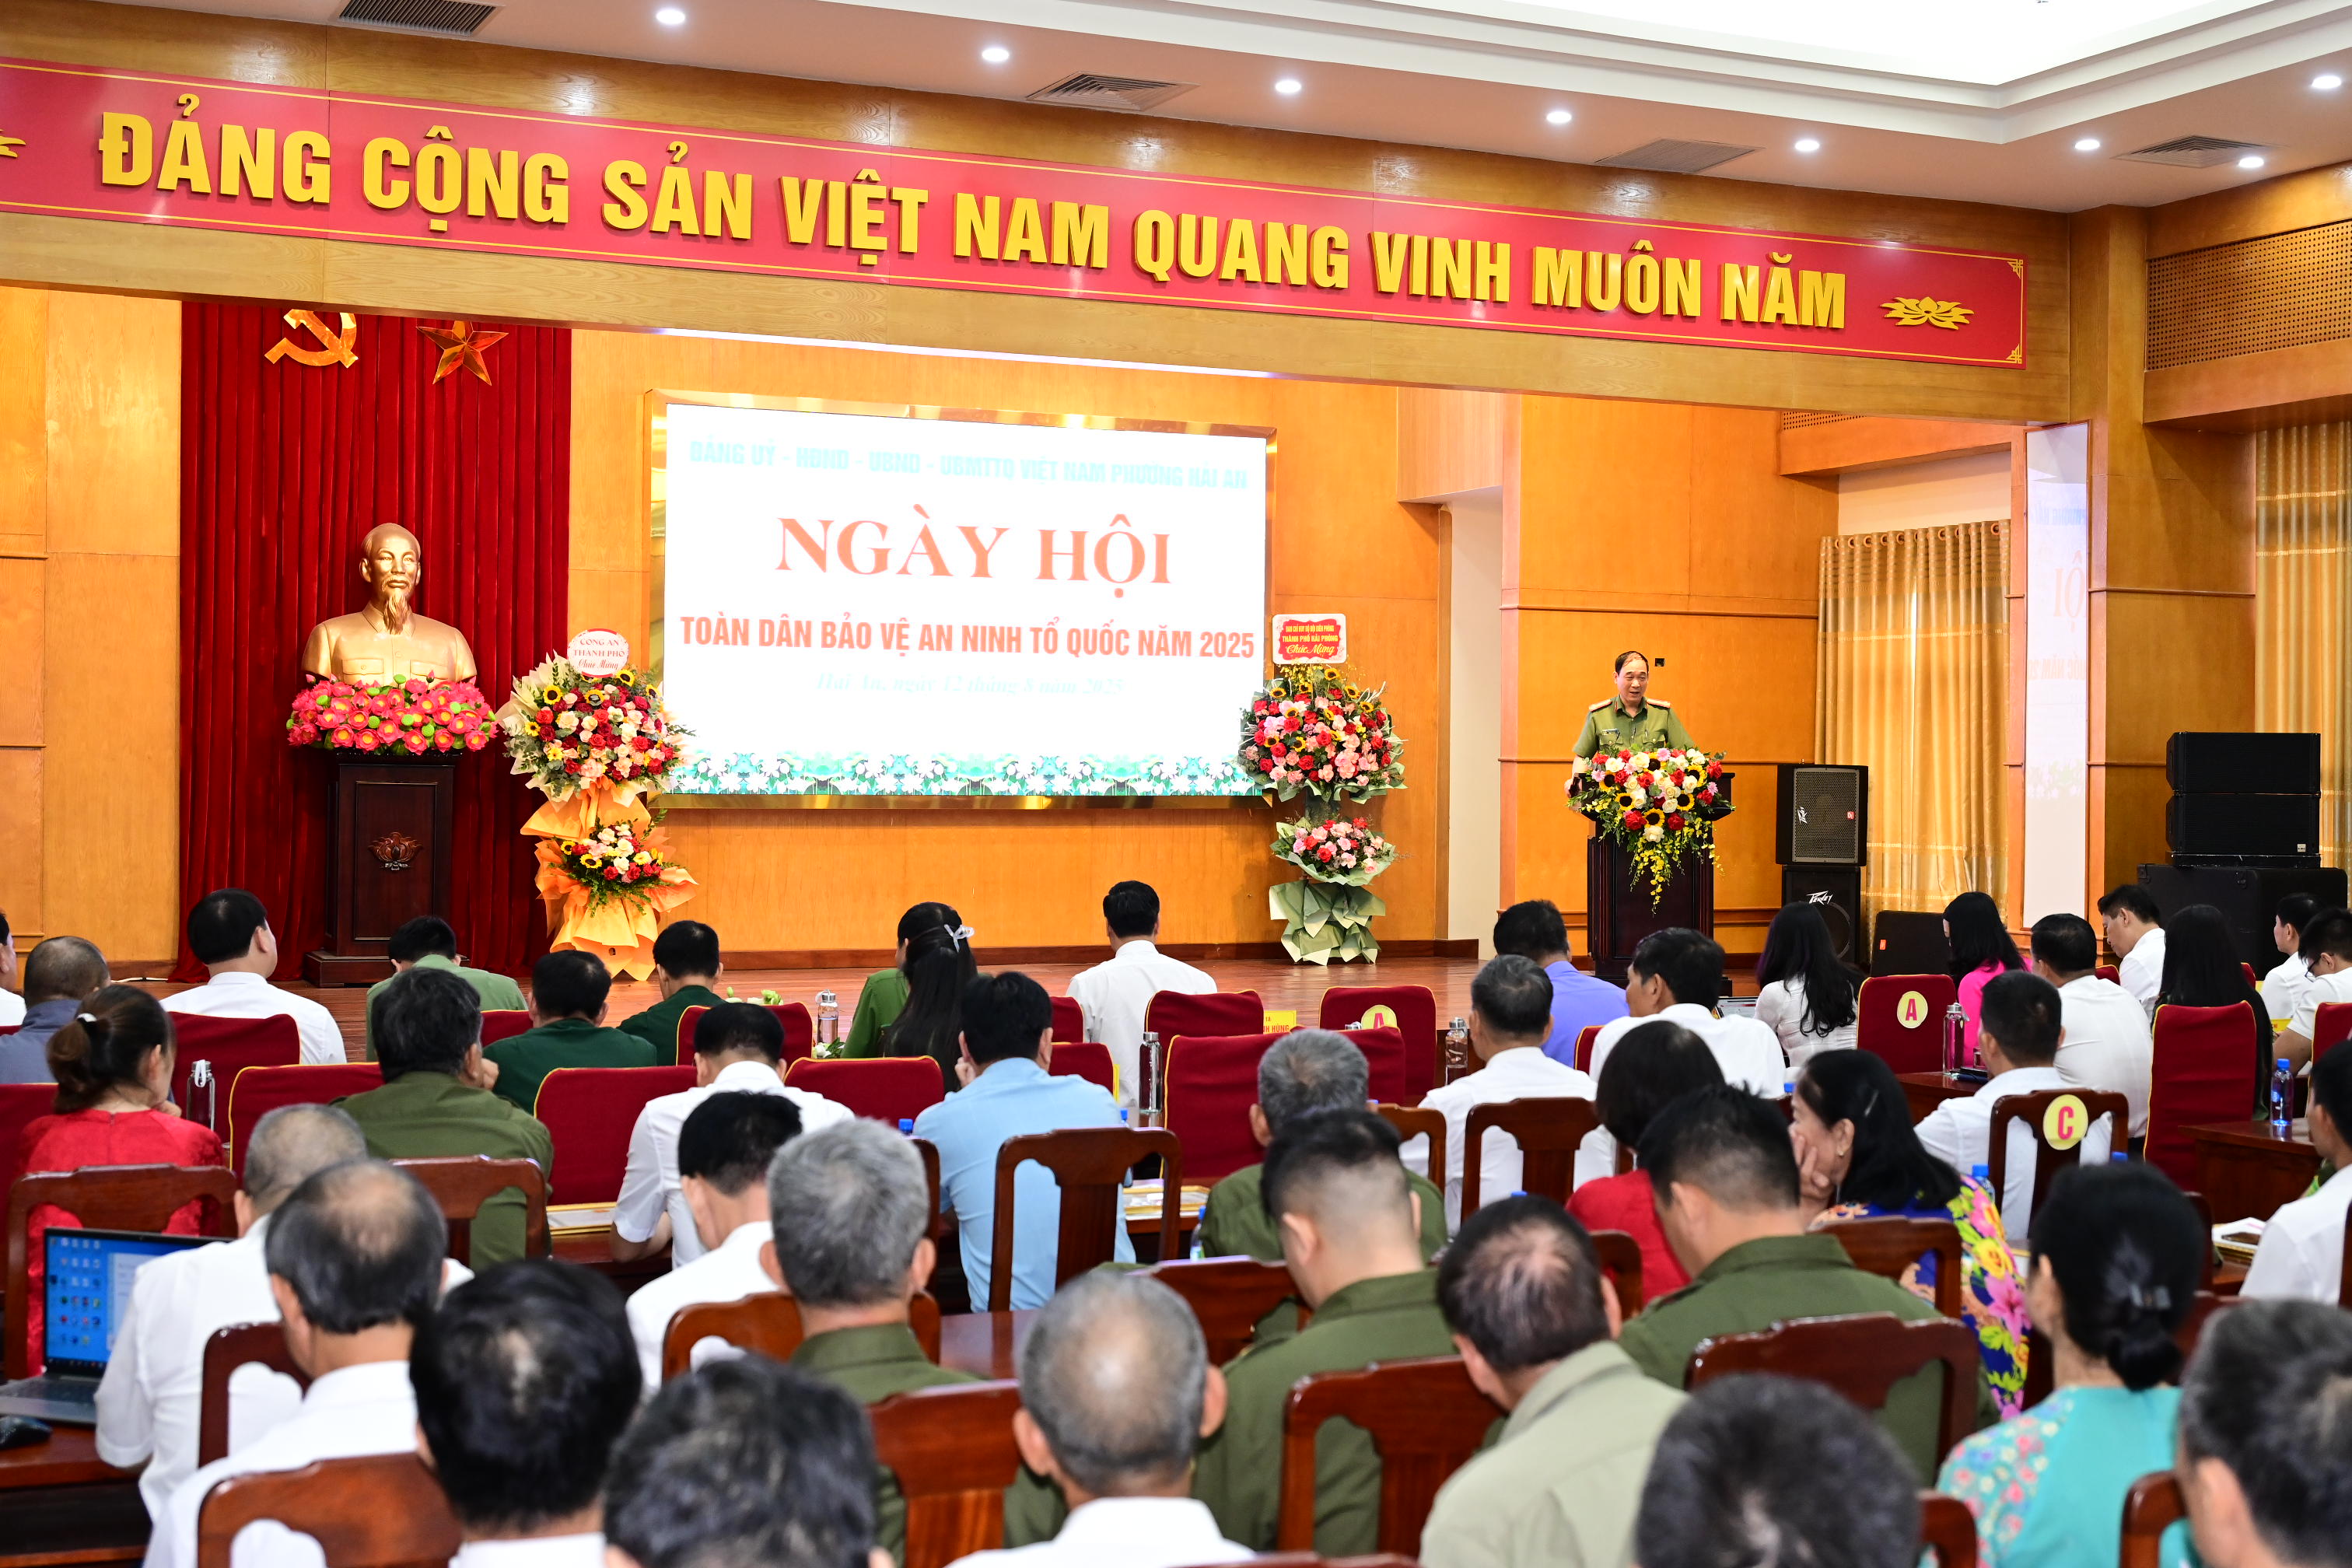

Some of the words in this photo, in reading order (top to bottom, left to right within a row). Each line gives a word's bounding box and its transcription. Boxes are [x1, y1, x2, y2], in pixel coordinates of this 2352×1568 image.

[99, 95, 331, 205] ĐẢNG
[362, 124, 570, 233] CỘNG
[602, 141, 754, 240] SẢN
[781, 168, 930, 266] VIỆT
[954, 192, 1111, 269] NAM
[1132, 209, 1351, 289] QUANG
[1370, 231, 1511, 303] VINH
[1531, 240, 1702, 317] MUÔN
[1720, 252, 1846, 330] NĂM
[796, 446, 849, 470] HĐND
[869, 451, 921, 473] UBND
[940, 454, 1016, 480] UBMTTQ
[1020, 455, 1059, 485] VIỆT
[1064, 461, 1106, 483] NAM
[1222, 468, 1248, 489] AN
[776, 504, 1010, 578] NGÀY
[1035, 514, 1171, 598] HỘI
[681, 611, 750, 646] TOÀN
[758, 613, 812, 648] DÂN
[821, 611, 872, 649] BẢO
[880, 617, 910, 657] VỆ
[919, 624, 953, 652] AN
[962, 625, 1021, 653] NINH
[1030, 616, 1060, 654] TỔ
[1066, 619, 1130, 658] QUỐC
[1138, 625, 1192, 657] NĂM
[1199, 632, 1255, 658] 2025
[1300, 633, 1311, 642] PHỐ
[1906, 998, 1917, 1021] A
[2058, 1105, 2074, 1140] C
